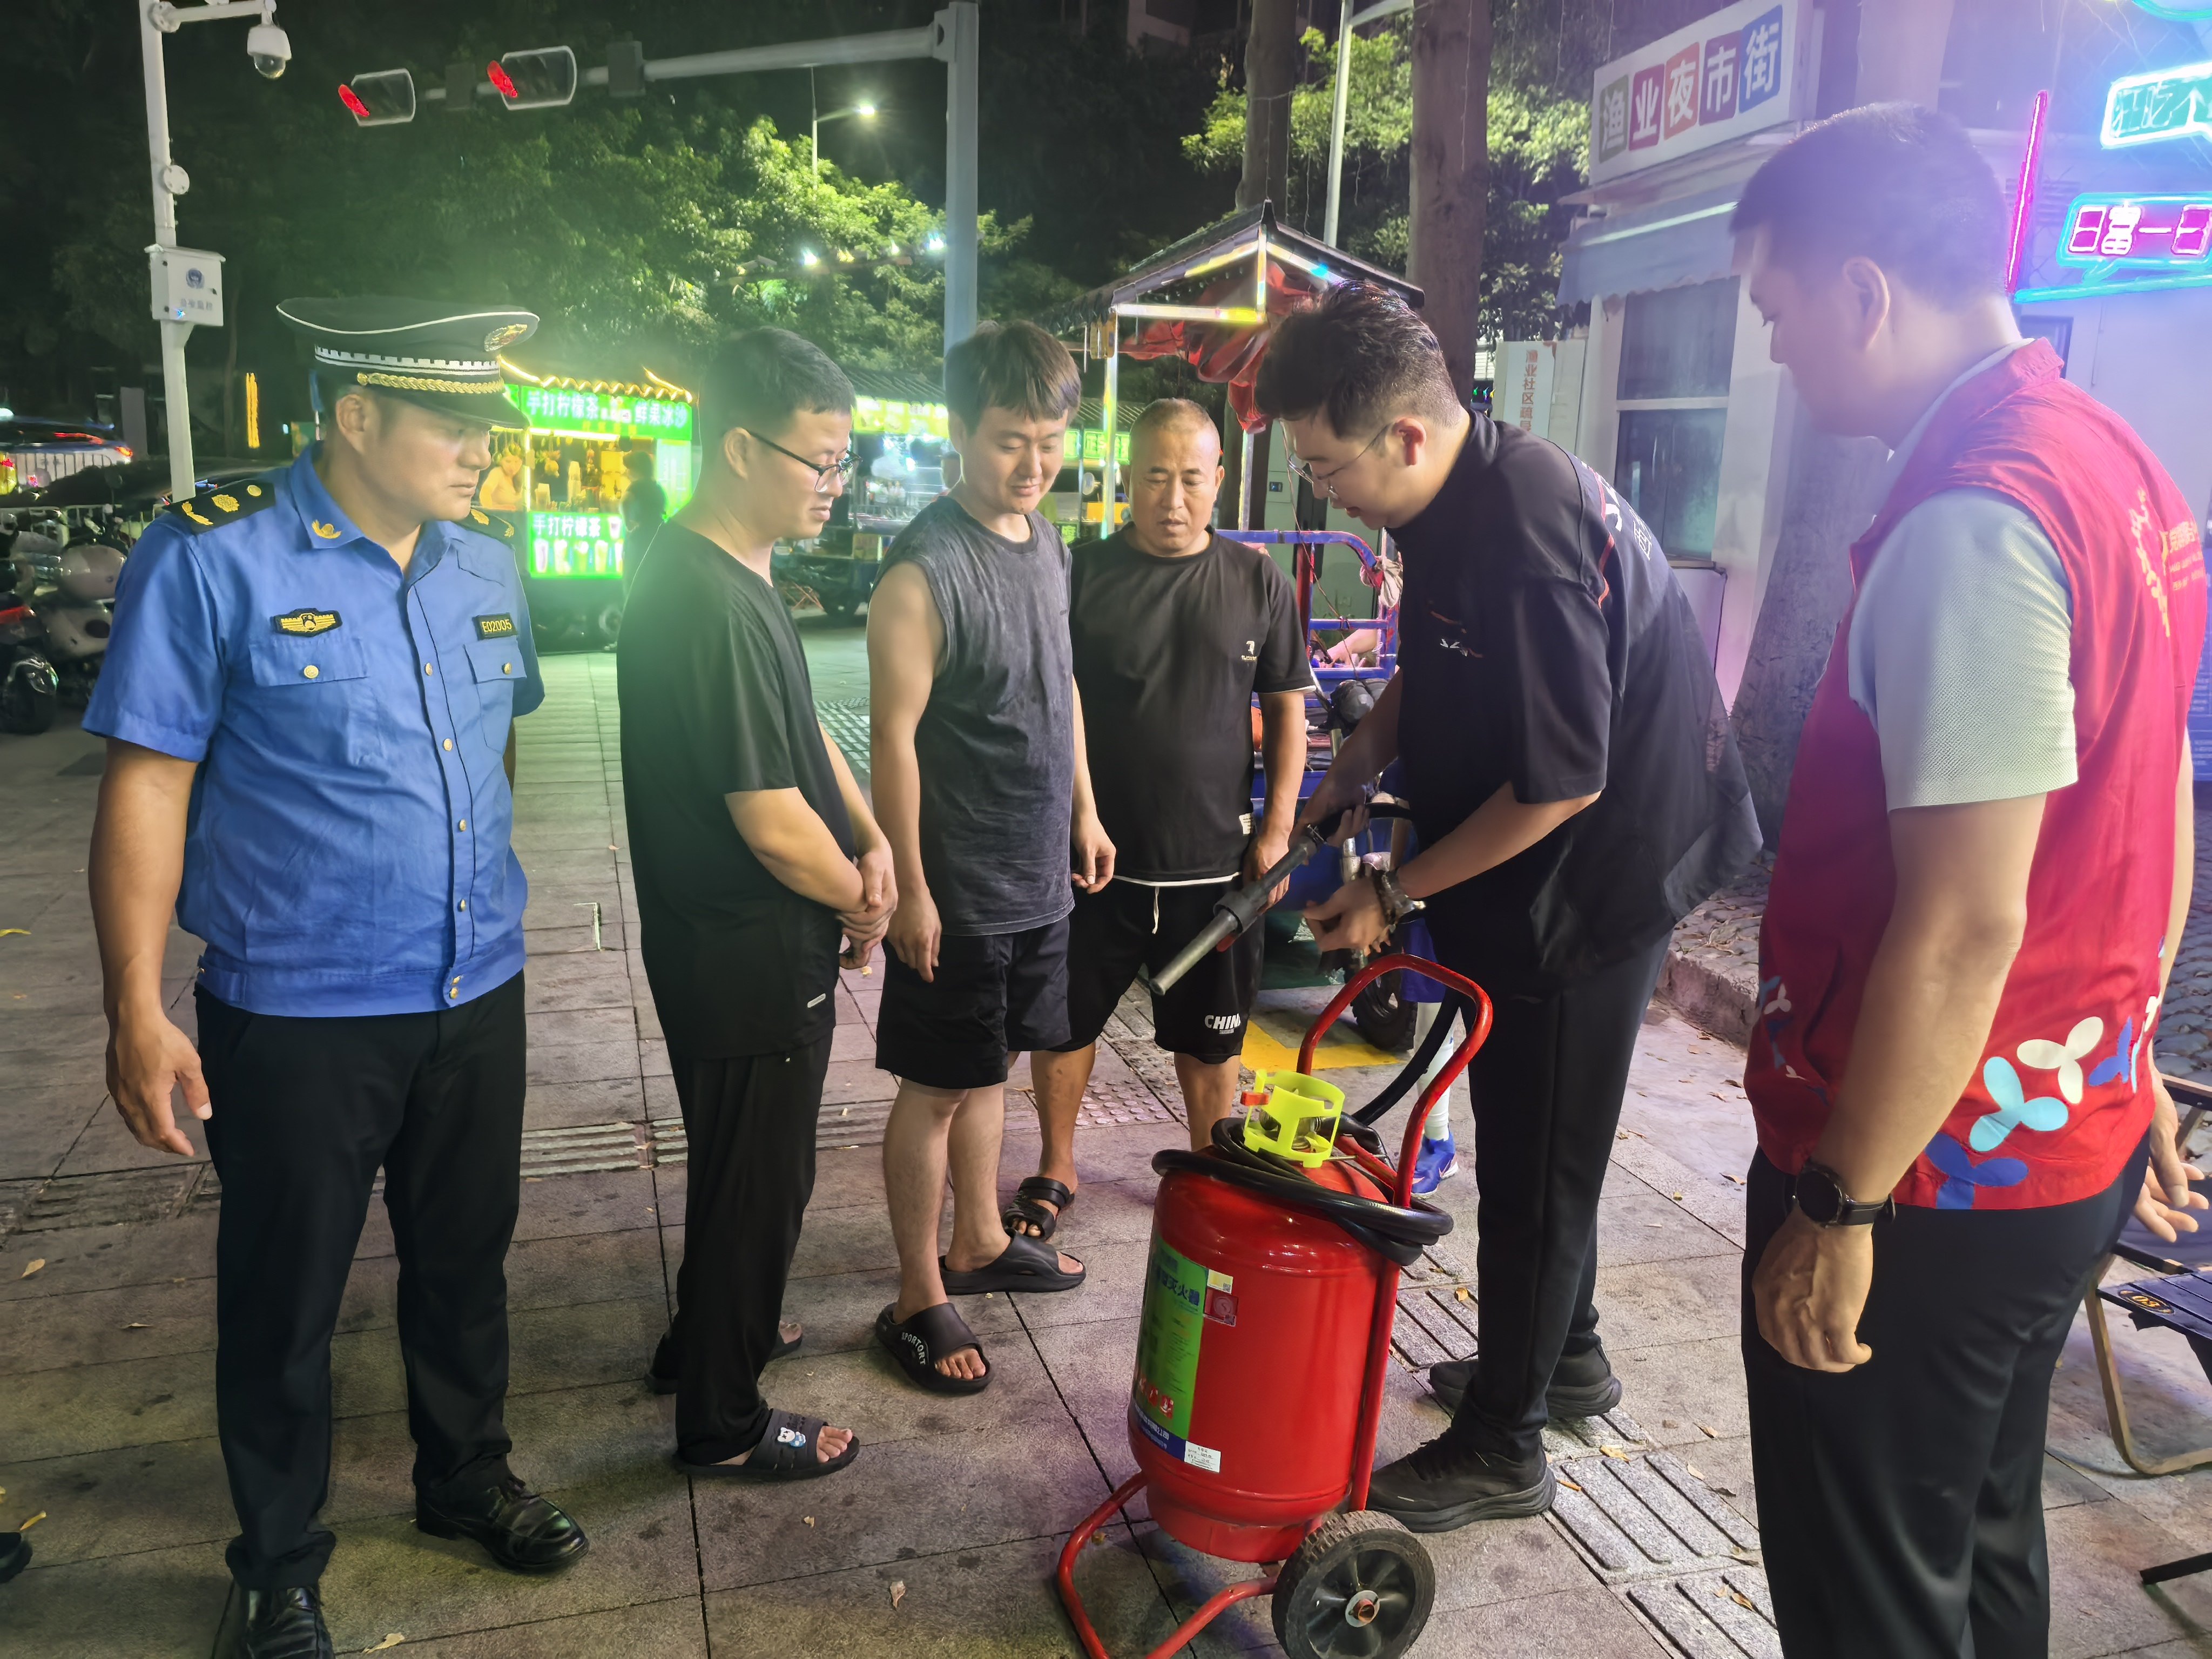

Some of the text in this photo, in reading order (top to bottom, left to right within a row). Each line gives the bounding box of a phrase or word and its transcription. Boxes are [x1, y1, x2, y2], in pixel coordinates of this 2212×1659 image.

[1602, 22, 1779, 152] 渔业夜市街
[526, 389, 598, 420] 手打柠檬茶
[533, 513, 601, 538] 手打柠檬茶
[481, 619, 512, 632] E02005
